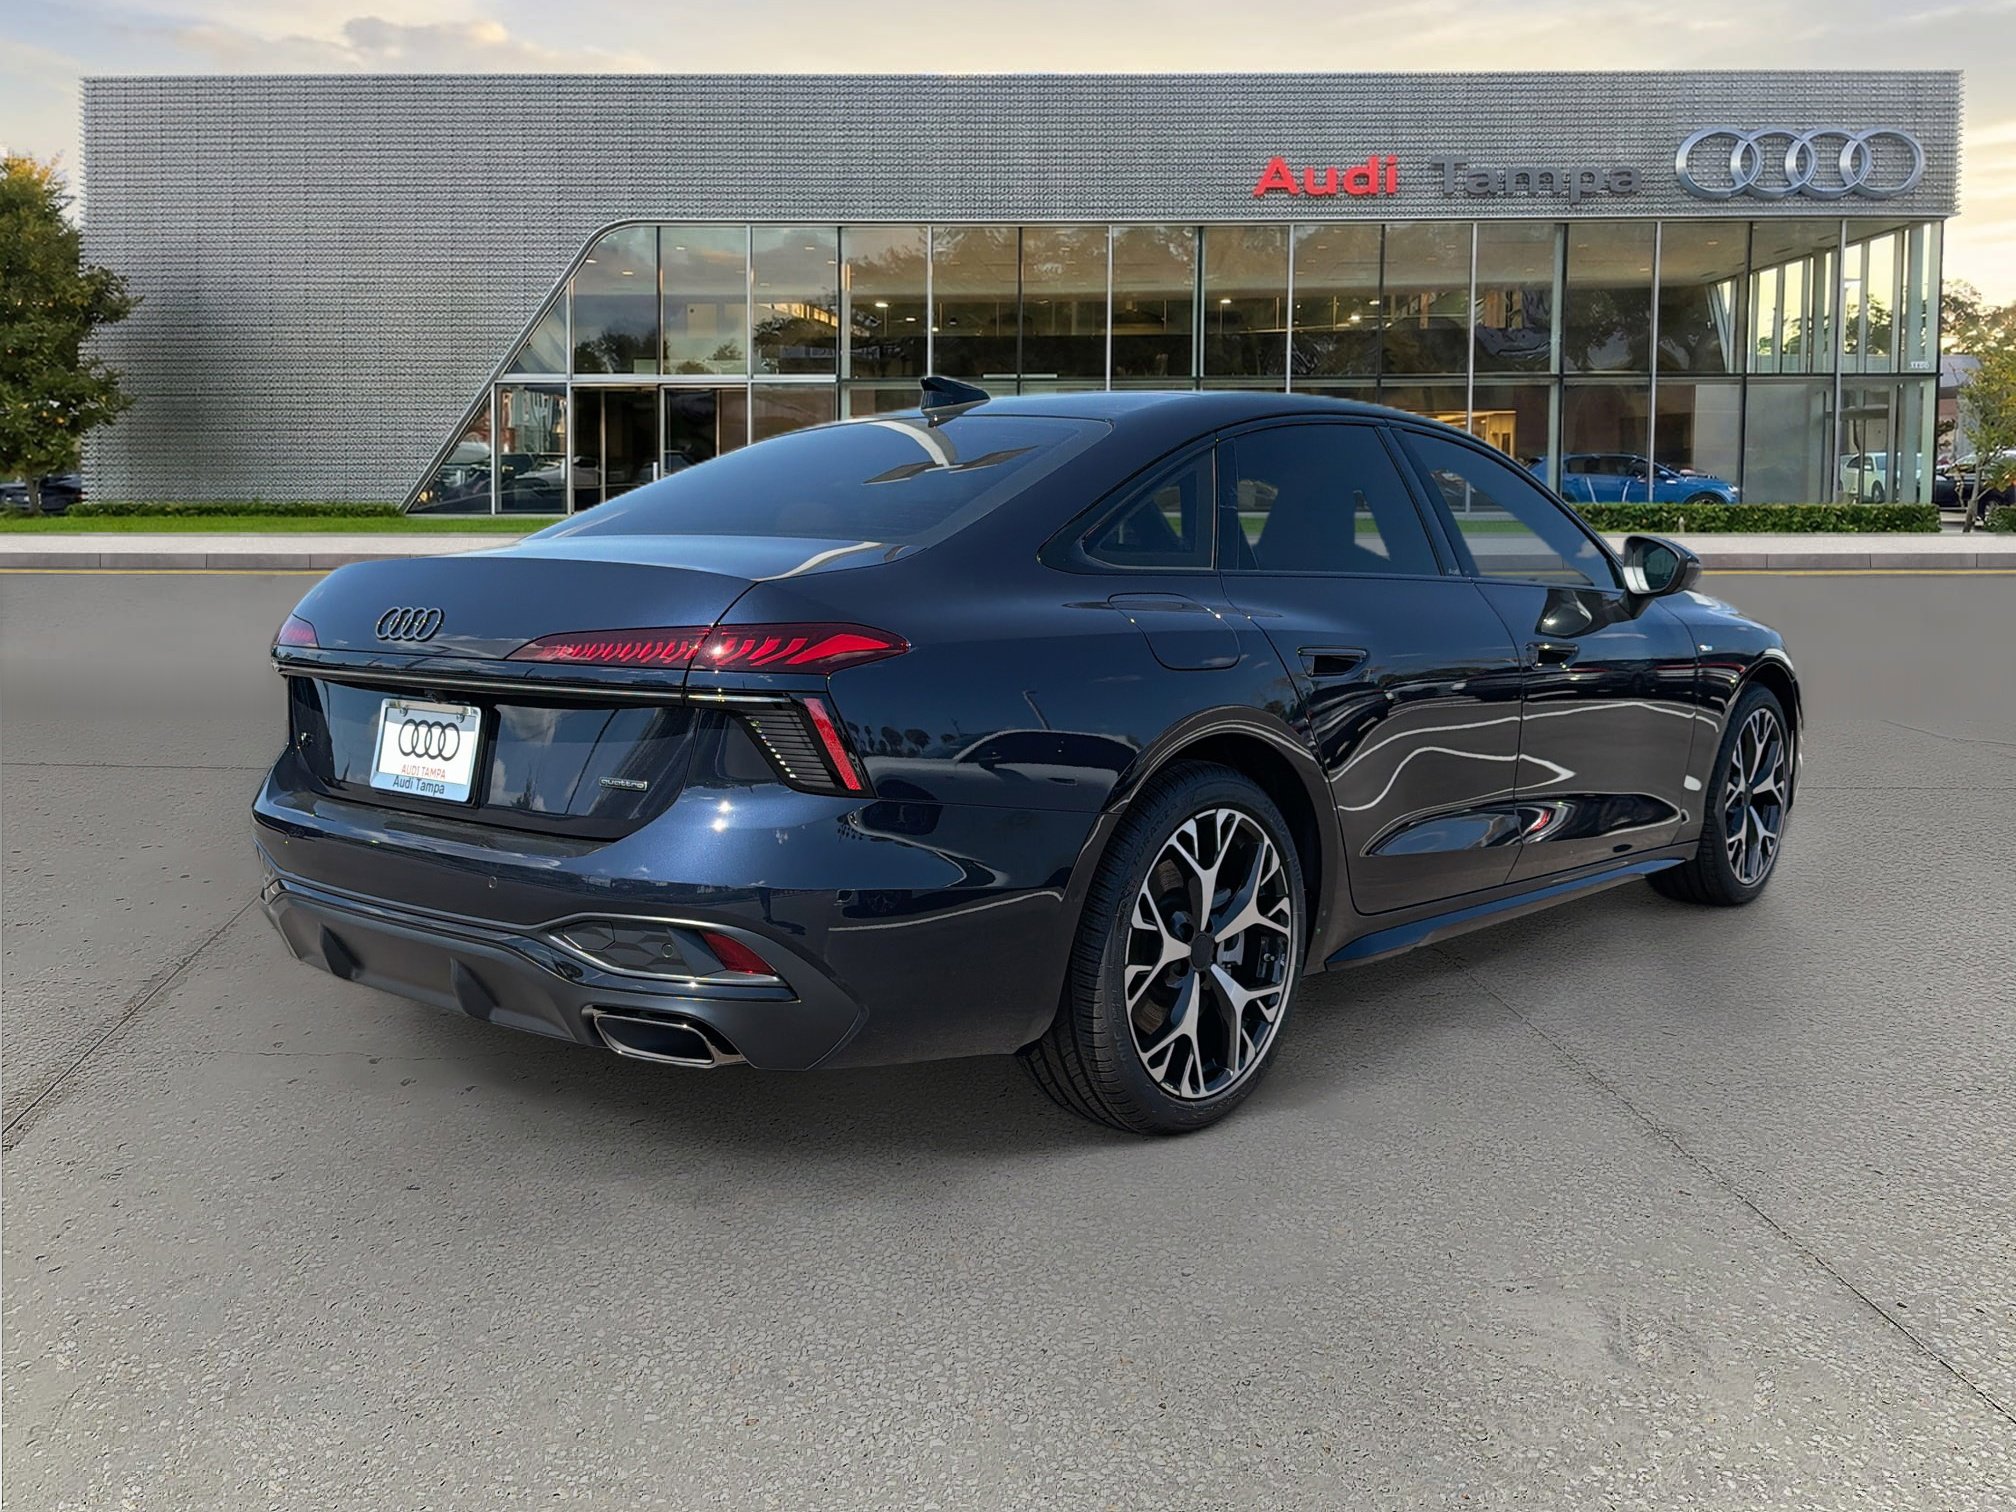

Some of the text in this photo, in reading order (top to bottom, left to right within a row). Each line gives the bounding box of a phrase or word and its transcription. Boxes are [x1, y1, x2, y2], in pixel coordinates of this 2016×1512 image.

[1253, 155, 1641, 205] Audi Tampa
[401, 764, 446, 779] AUDI TAMPA
[392, 775, 445, 795] Audi Tampa
[601, 779, 644, 788] quattro
